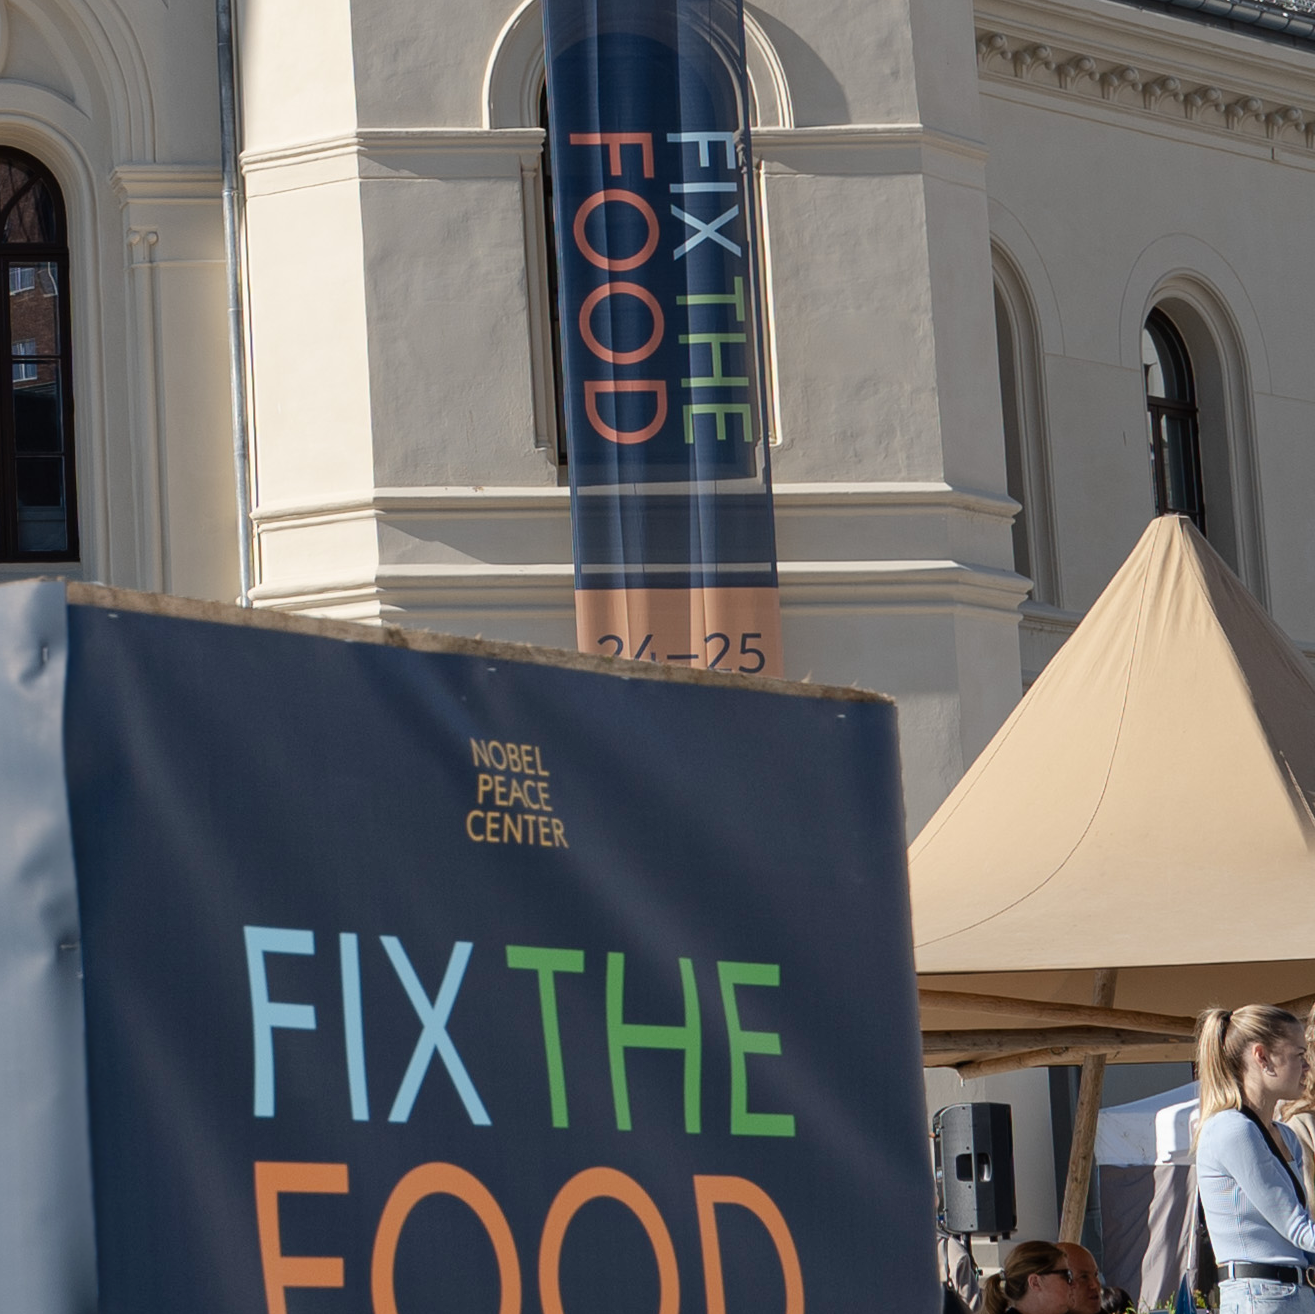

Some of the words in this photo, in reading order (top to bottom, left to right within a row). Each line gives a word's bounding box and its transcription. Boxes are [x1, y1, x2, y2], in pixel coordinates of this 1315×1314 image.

[667, 132, 741, 261] FIX
[570, 132, 667, 445] FOOD
[676, 276, 753, 444] THE
[471, 737, 549, 777] NOBEL
[478, 773, 553, 812] PEACE
[466, 810, 569, 849] CENTER
[244, 925, 492, 1126] FIX
[506, 944, 796, 1137] THE
